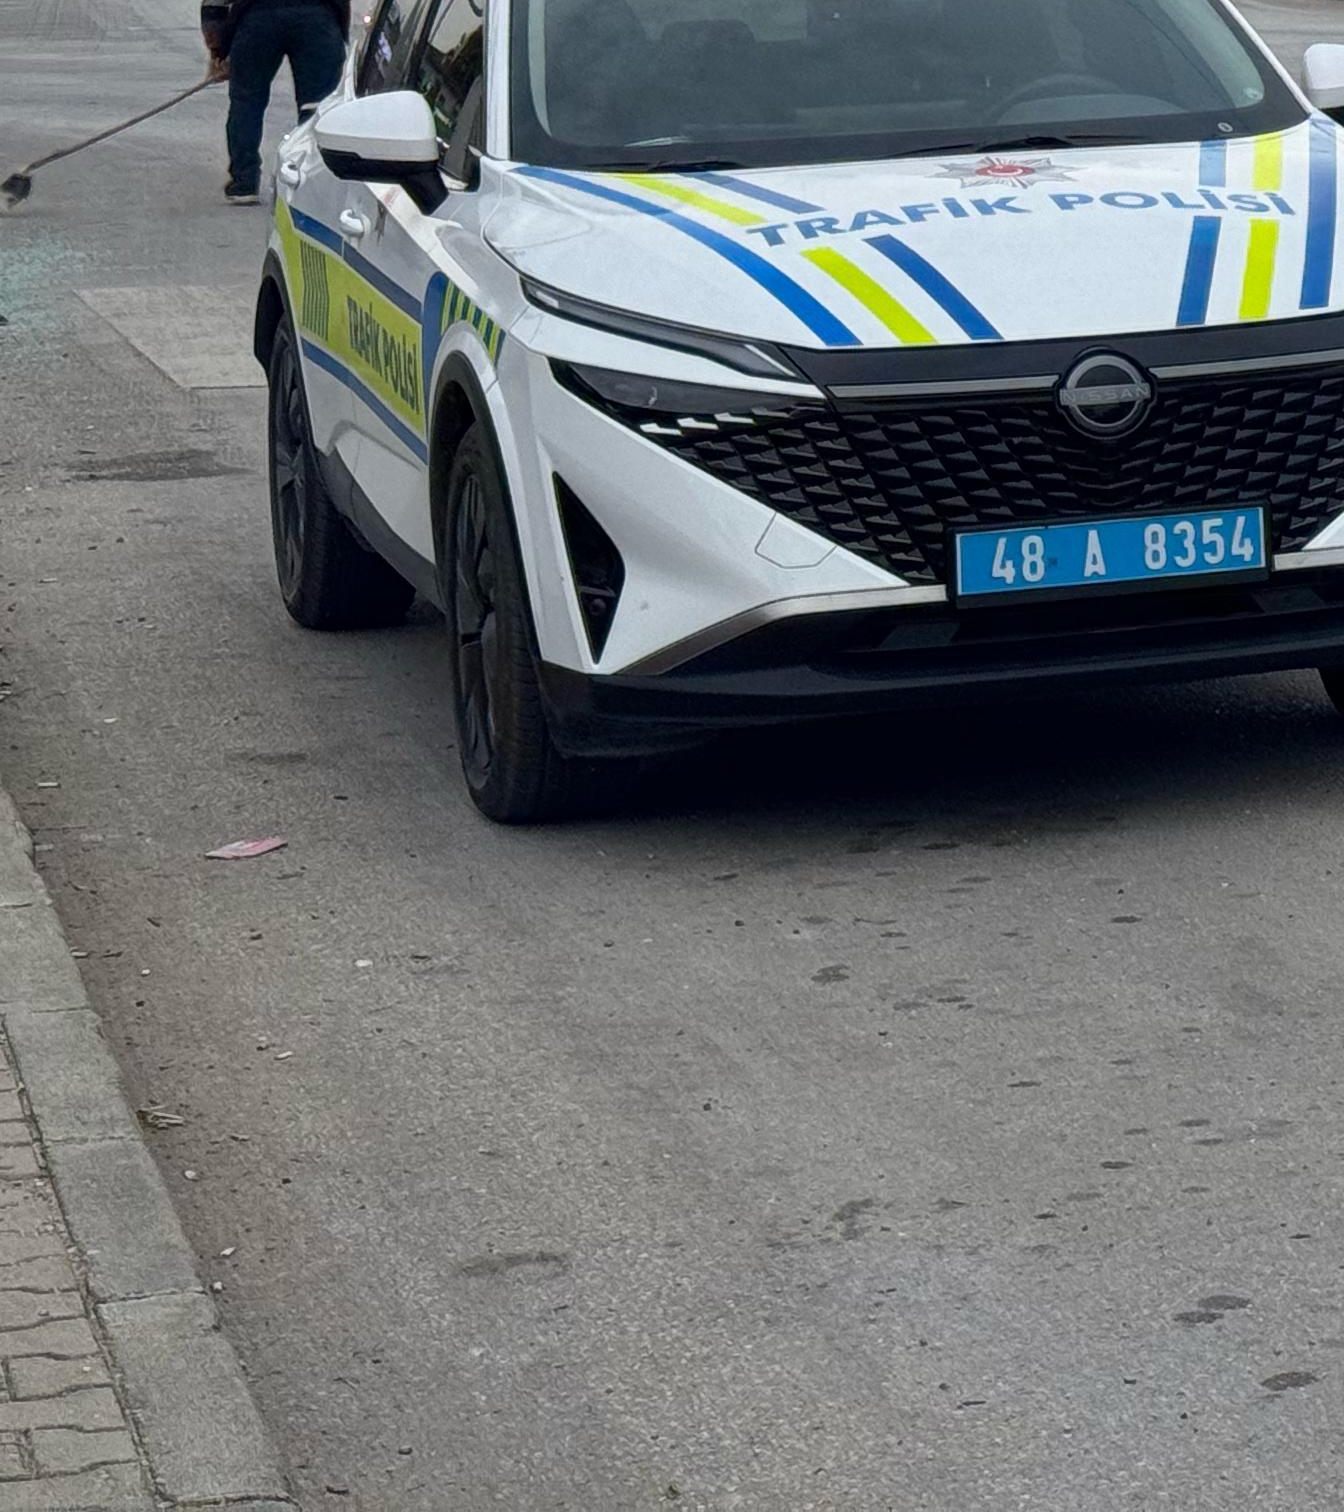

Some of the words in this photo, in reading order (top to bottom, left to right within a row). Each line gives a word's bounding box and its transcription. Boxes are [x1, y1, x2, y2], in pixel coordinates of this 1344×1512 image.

[746, 196, 1034, 248] TRAFİK
[1047, 188, 1297, 216] POLİSİ
[346, 294, 382, 378] TRAFİK
[382, 326, 420, 416] POLİSİ
[1061, 384, 1149, 404] NISSAN
[991, 534, 1046, 584] 48
[1083, 529, 1107, 578] A
[1143, 515, 1254, 571] 8354
